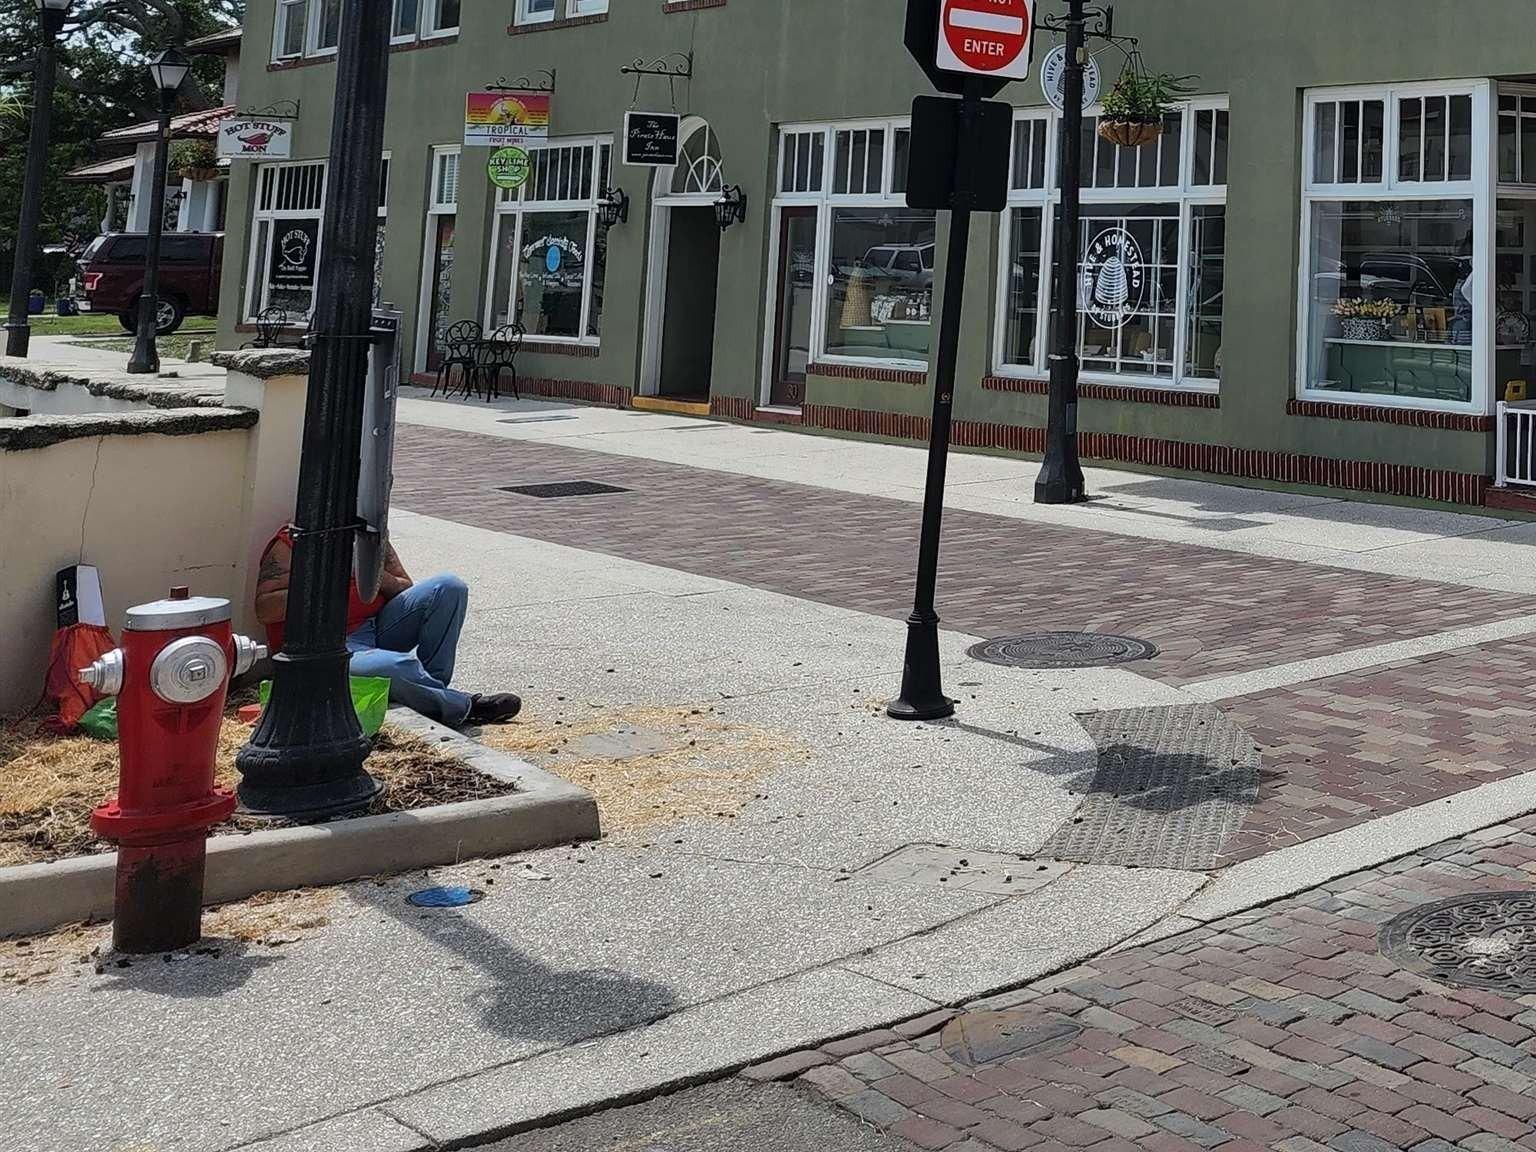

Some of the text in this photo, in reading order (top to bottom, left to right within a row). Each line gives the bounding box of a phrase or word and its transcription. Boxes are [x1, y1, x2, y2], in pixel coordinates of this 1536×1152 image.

[964, 39, 1005, 56] ENTER
[1046, 60, 1057, 82] HIVE
[224, 122, 287, 136] HOT STUFF
[486, 126, 528, 135] TROPICAL
[489, 157, 530, 166] KEY LIME
[1084, 234, 1140, 288] HIVE & HOMESTEAD
